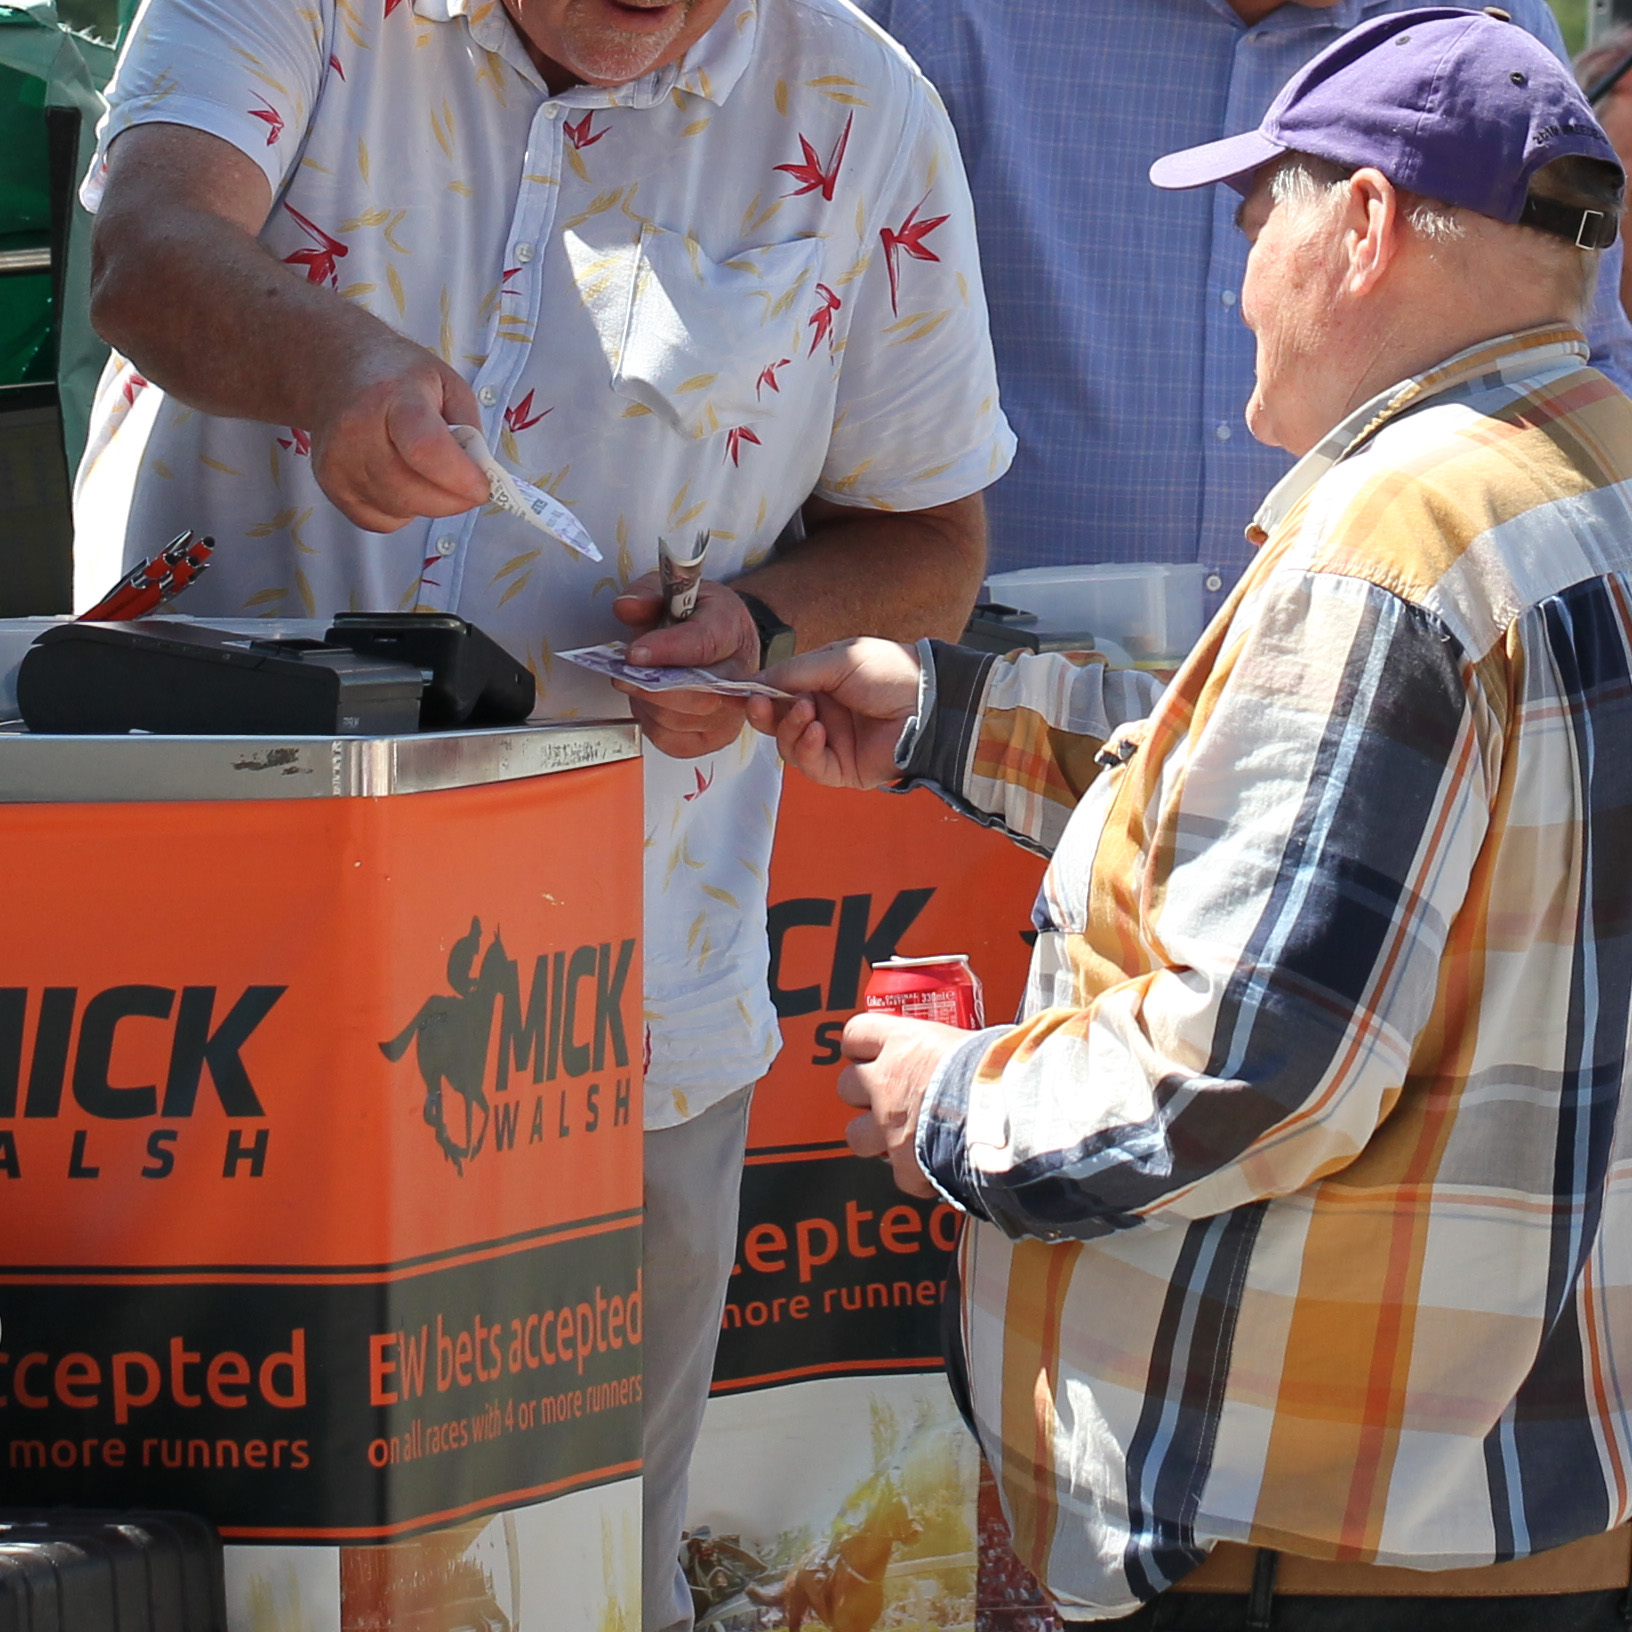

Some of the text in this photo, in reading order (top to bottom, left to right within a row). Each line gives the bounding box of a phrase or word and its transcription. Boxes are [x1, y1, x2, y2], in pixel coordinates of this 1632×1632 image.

[769, 887, 936, 1023] CK
[496, 938, 636, 1092] MICK
[494, 1076, 632, 1152] WALSH
[369, 1267, 644, 1407] EW bets accepted
[823, 1280, 948, 1314] runner
[9, 1438, 126, 1467] more
[142, 1438, 310, 1470] runners
[368, 1374, 644, 1468] on all races with 4 or more runners
